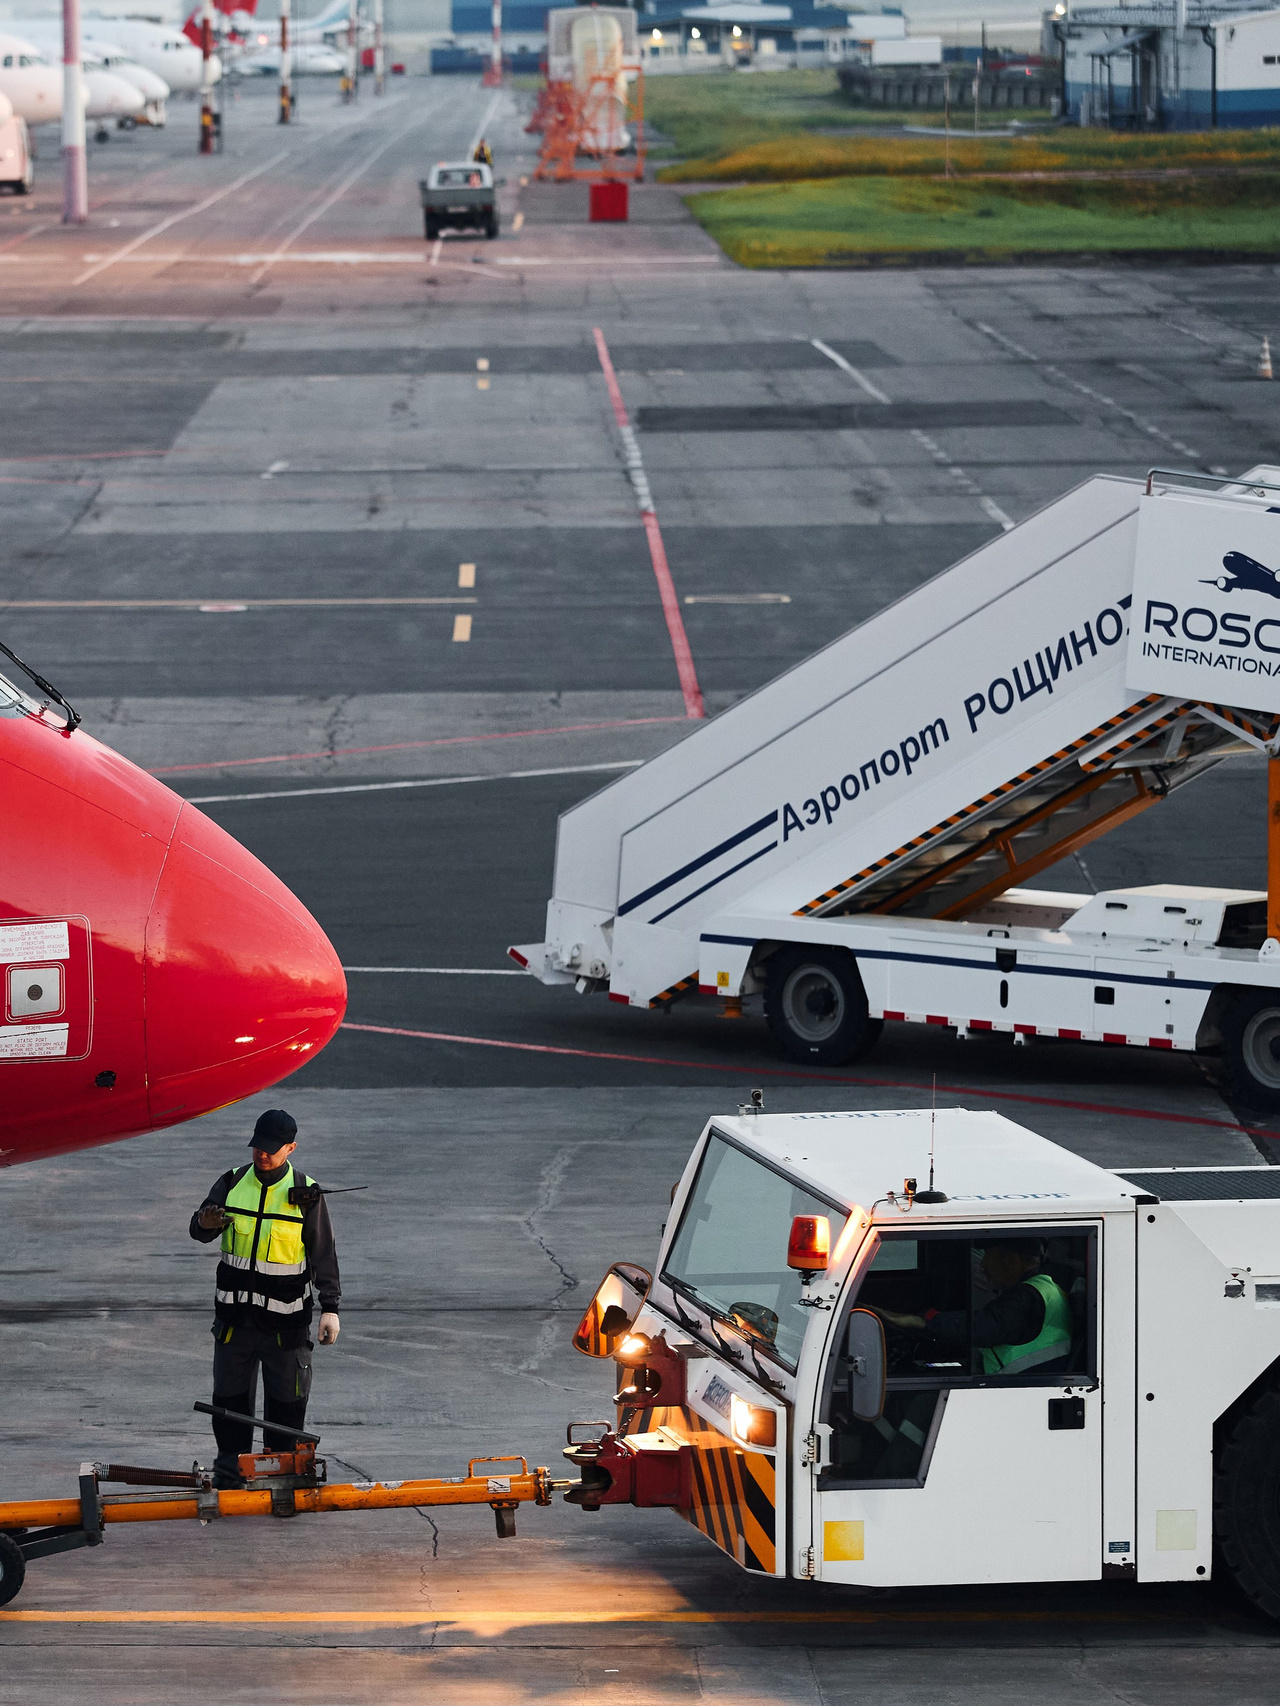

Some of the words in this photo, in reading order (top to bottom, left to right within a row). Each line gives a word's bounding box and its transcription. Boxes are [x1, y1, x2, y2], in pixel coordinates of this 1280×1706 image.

[782, 717, 950, 842] Аэропорт
[963, 608, 1123, 734] РОЩИНО
[948, 1192, 1070, 1201] CHOPF
